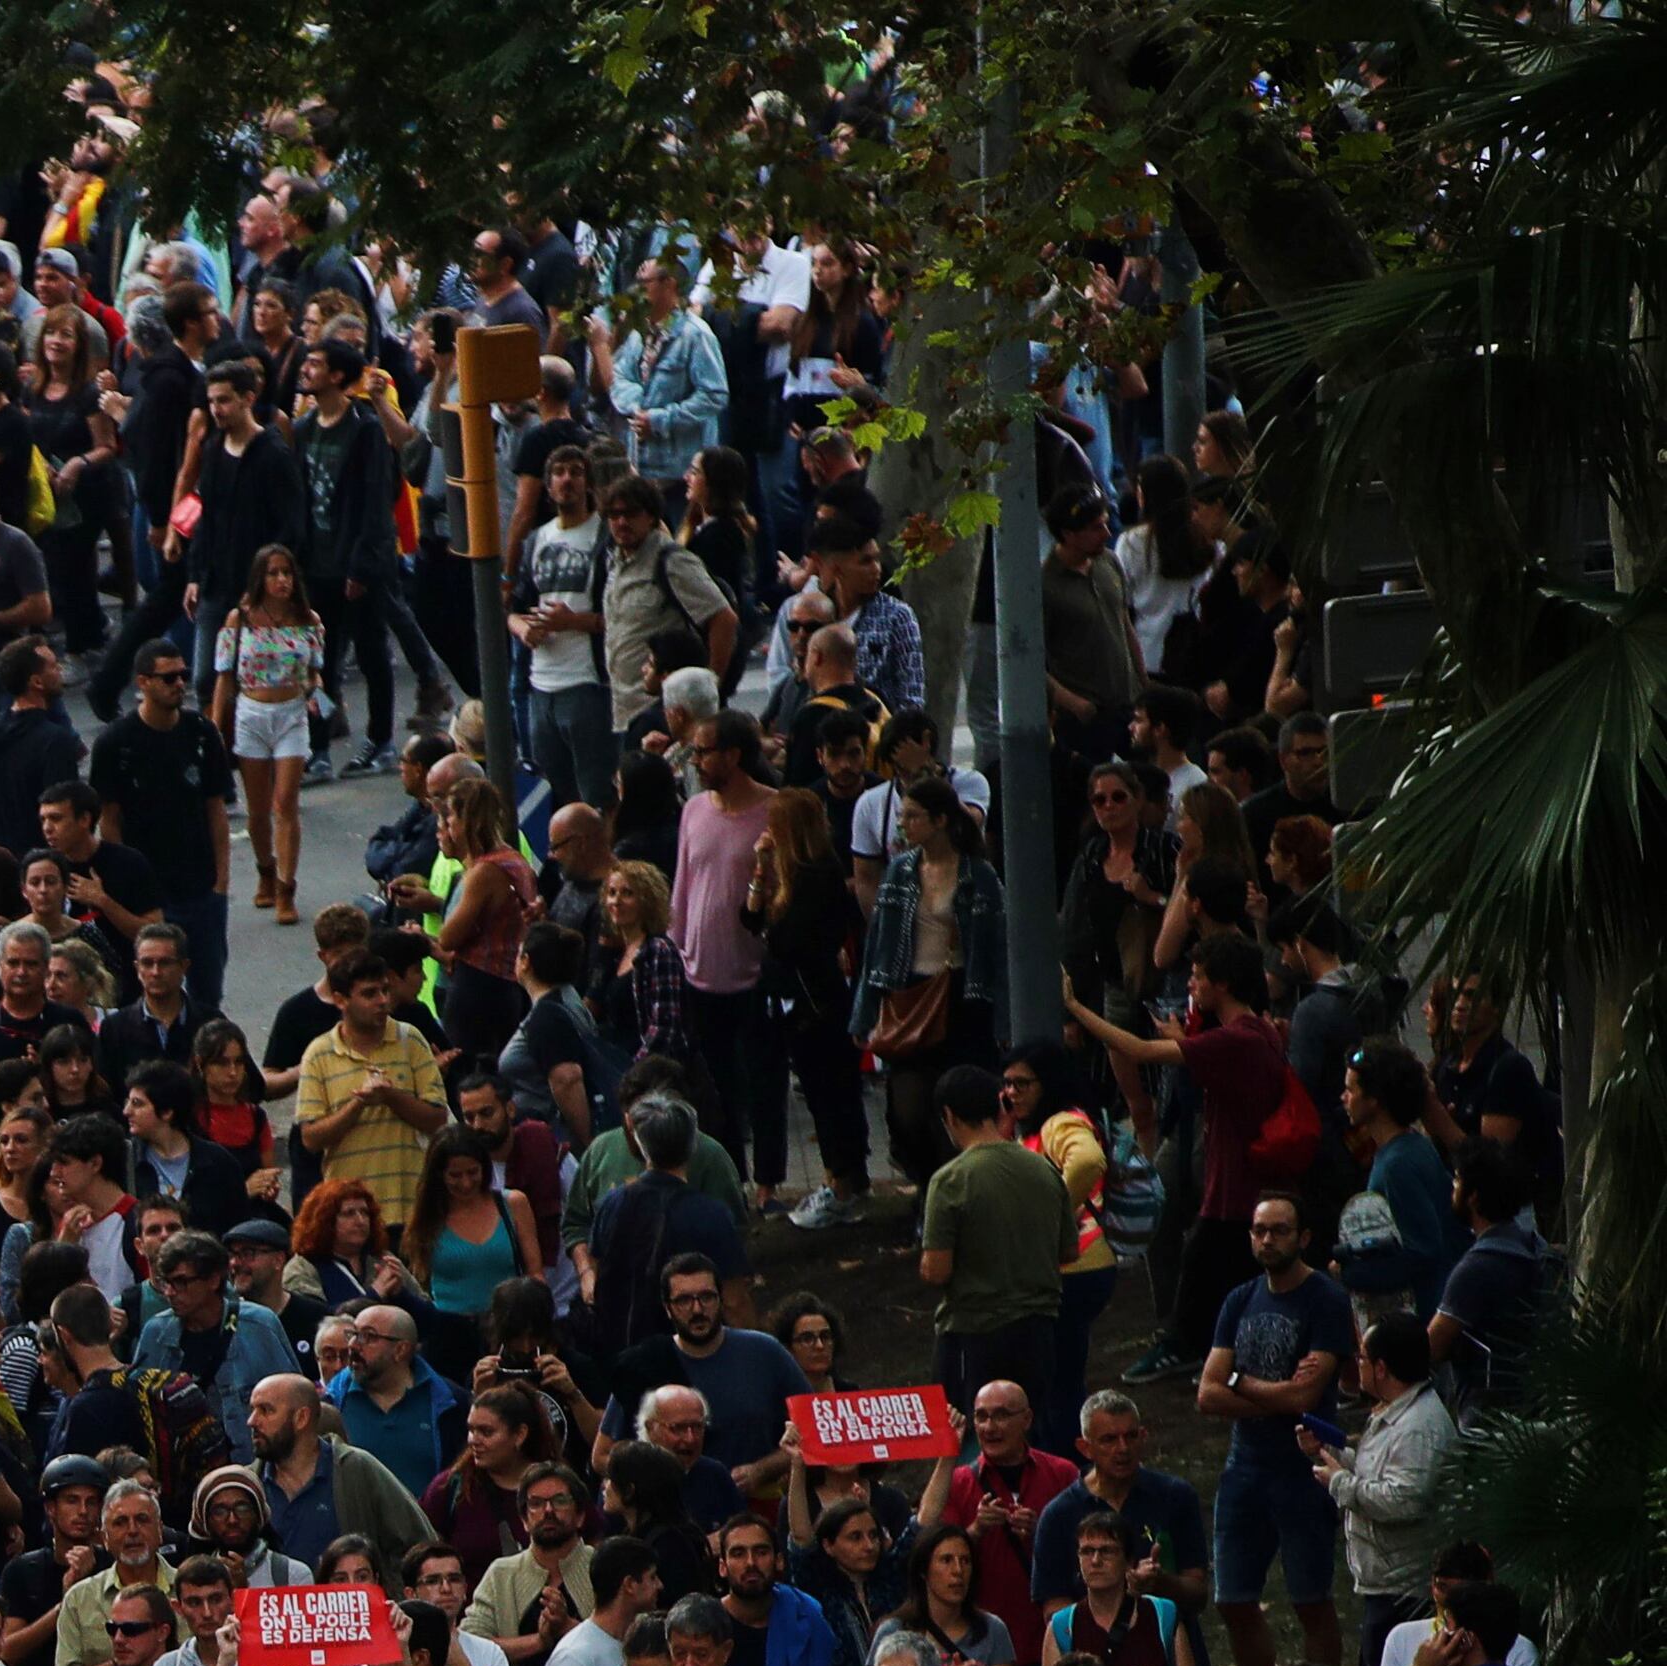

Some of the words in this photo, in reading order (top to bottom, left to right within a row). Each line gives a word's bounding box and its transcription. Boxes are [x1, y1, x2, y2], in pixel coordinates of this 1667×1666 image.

[836, 1400, 857, 1417] AL
[859, 1393, 924, 1415] CARRER
[815, 1416, 844, 1432] ON
[846, 1414, 868, 1429] EL
[871, 1408, 928, 1427] POBLE
[819, 1429, 844, 1444] ES
[846, 1421, 931, 1441] DEFENSA
[283, 1594, 302, 1613] AL
[306, 1590, 368, 1613] CARRER
[260, 1613, 287, 1630] ON
[291, 1611, 311, 1629] EL
[316, 1608, 371, 1628] POBLE
[262, 1629, 285, 1646] ES
[289, 1625, 371, 1644] DEFENSA
